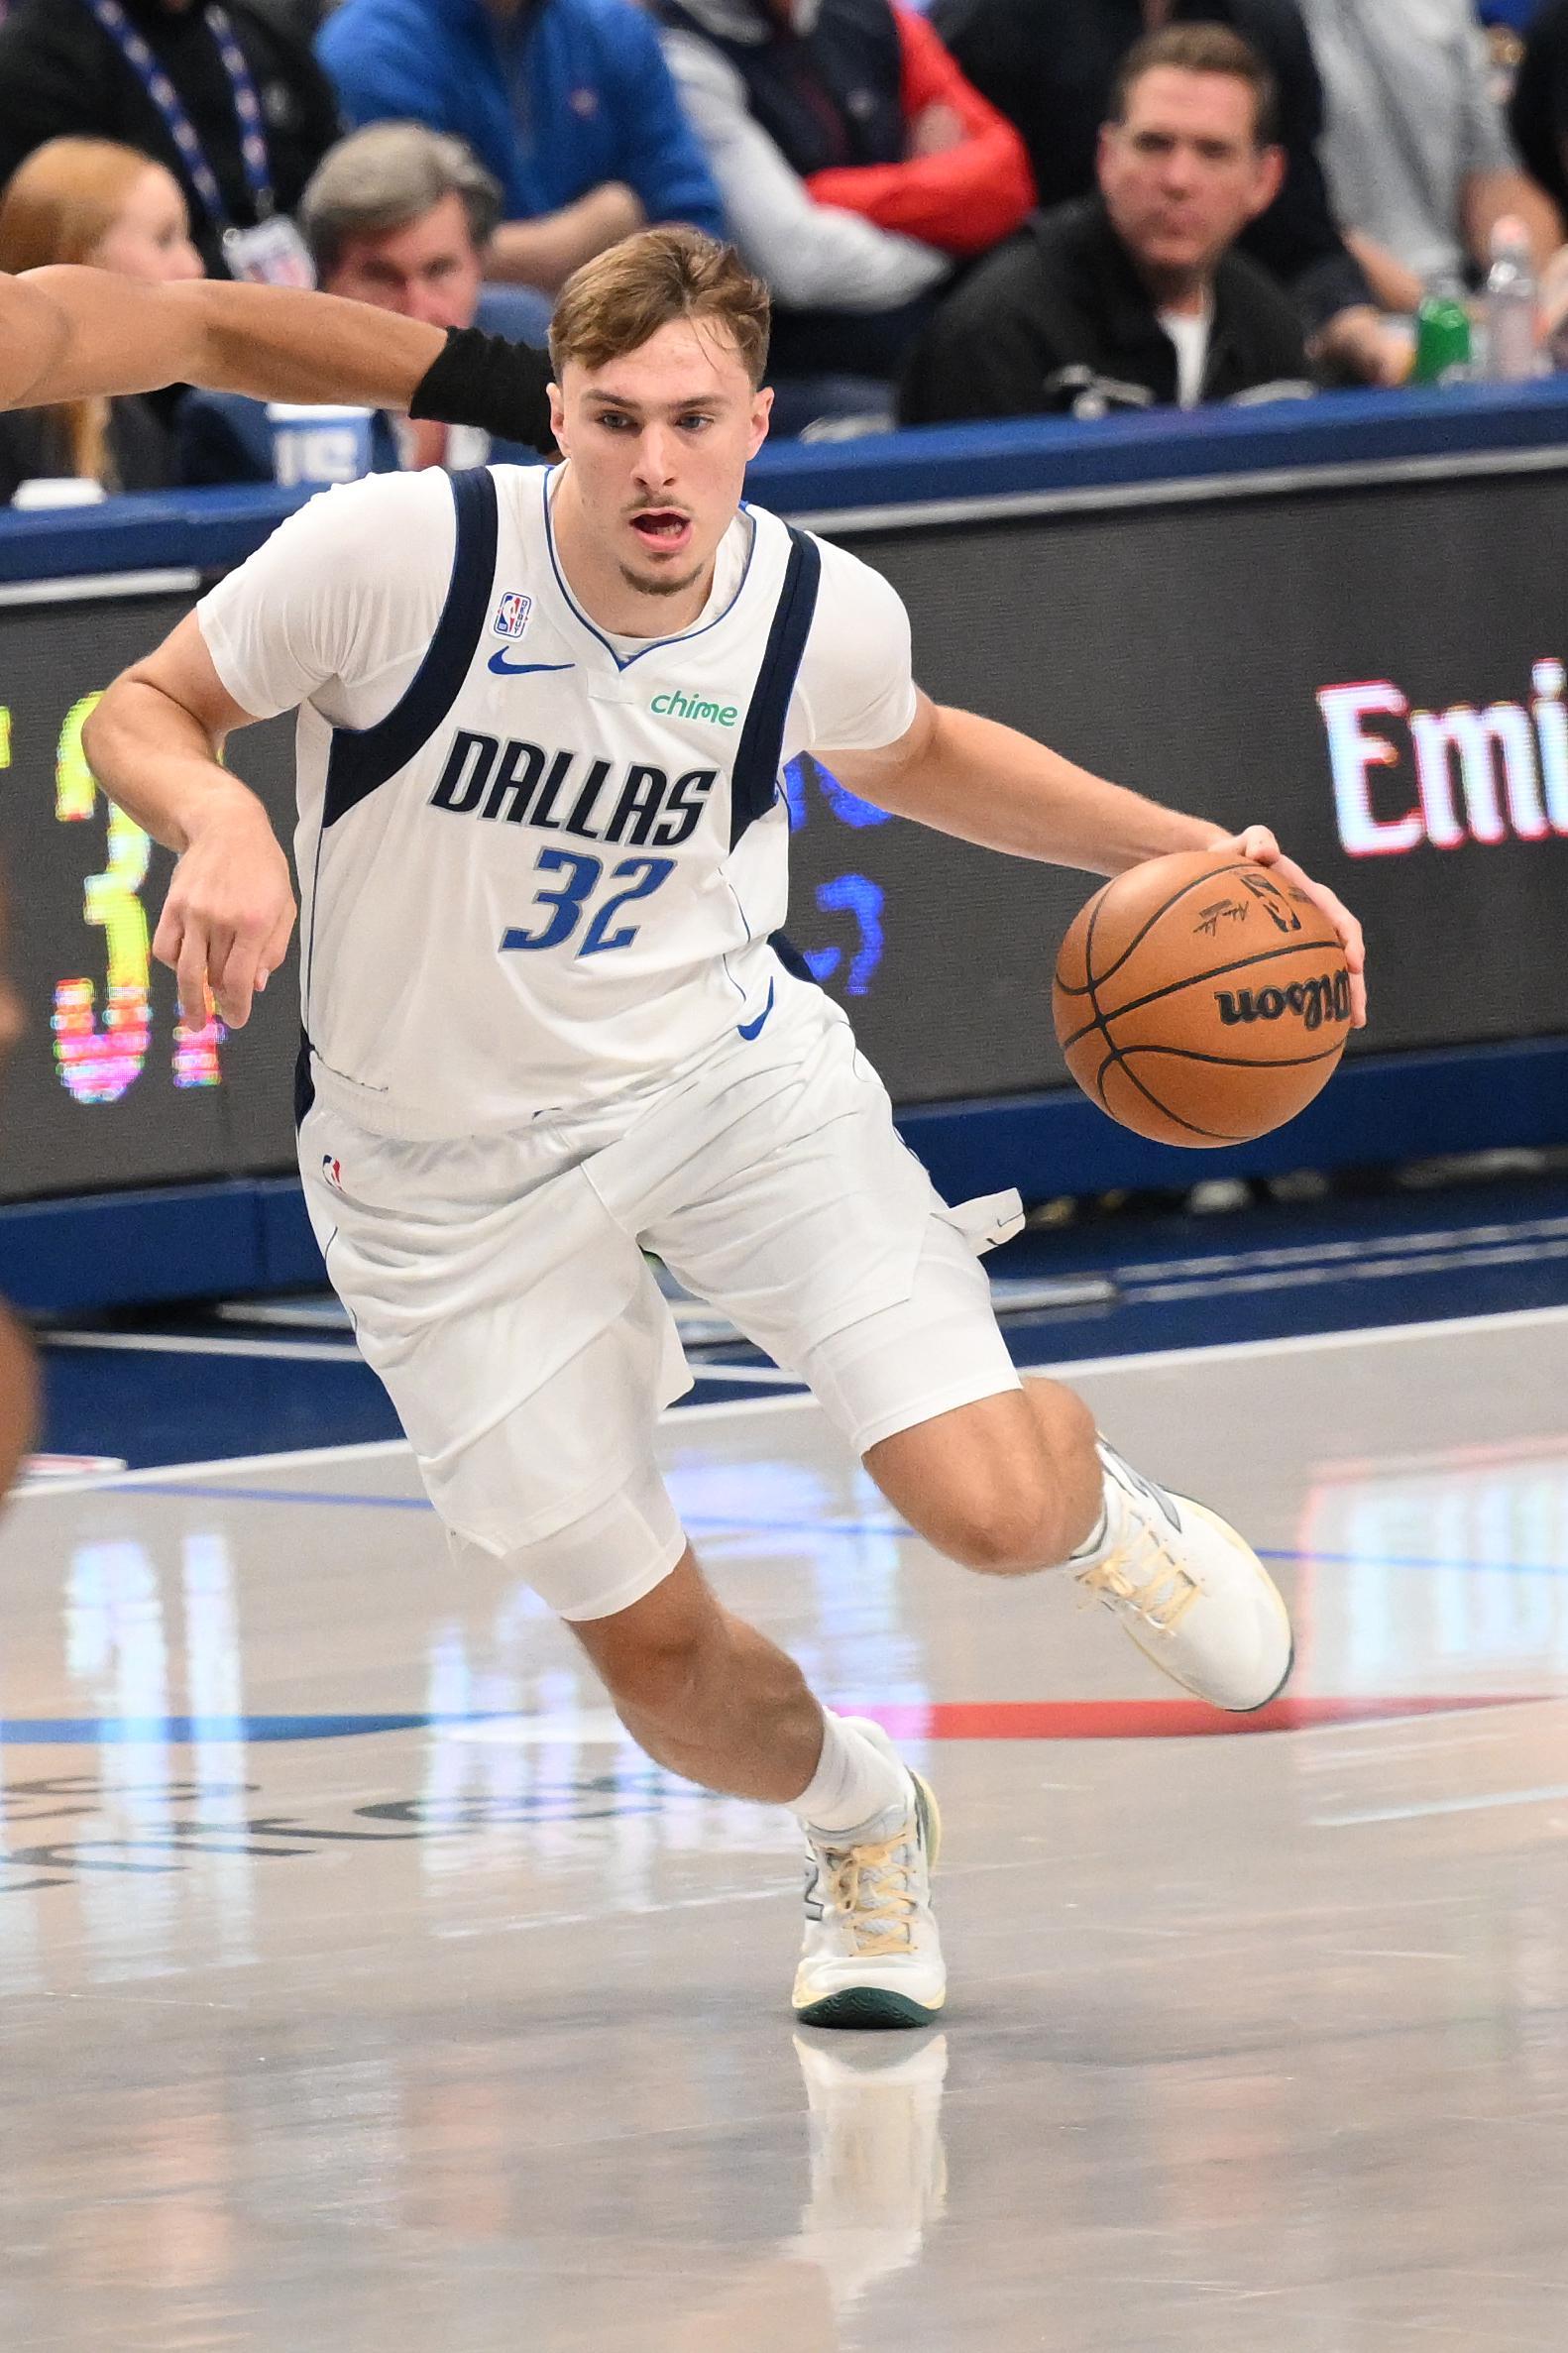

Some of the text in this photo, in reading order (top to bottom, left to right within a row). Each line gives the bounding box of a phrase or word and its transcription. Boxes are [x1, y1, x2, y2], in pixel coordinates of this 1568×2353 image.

[650, 690, 738, 727] chime
[428, 727, 721, 849] DALLAS
[498, 845, 678, 961] 32
